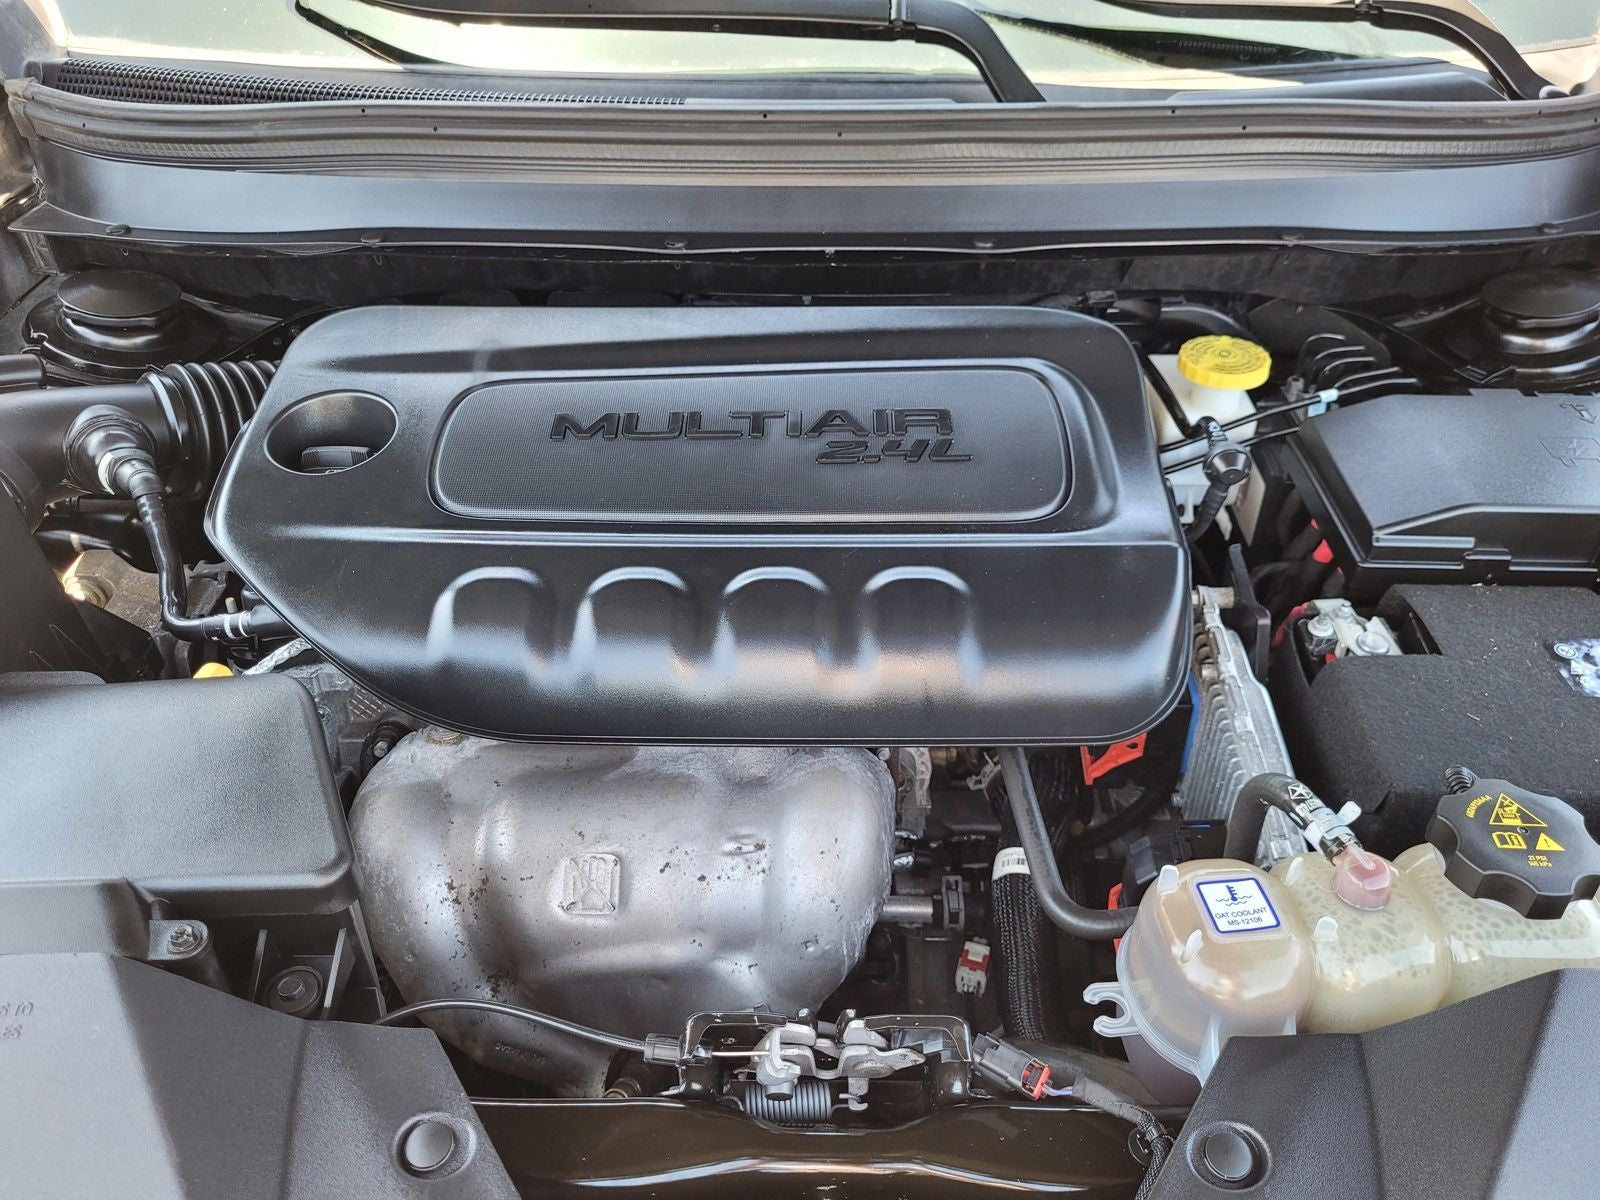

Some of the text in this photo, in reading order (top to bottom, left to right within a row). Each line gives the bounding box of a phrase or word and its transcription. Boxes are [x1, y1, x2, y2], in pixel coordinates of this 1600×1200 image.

[550, 408, 954, 440] MULTIAIR
[815, 438, 974, 465] 2.4L
[1227, 917, 1263, 926] MS-12106
[1231, 907, 1267, 918] COOLANT
